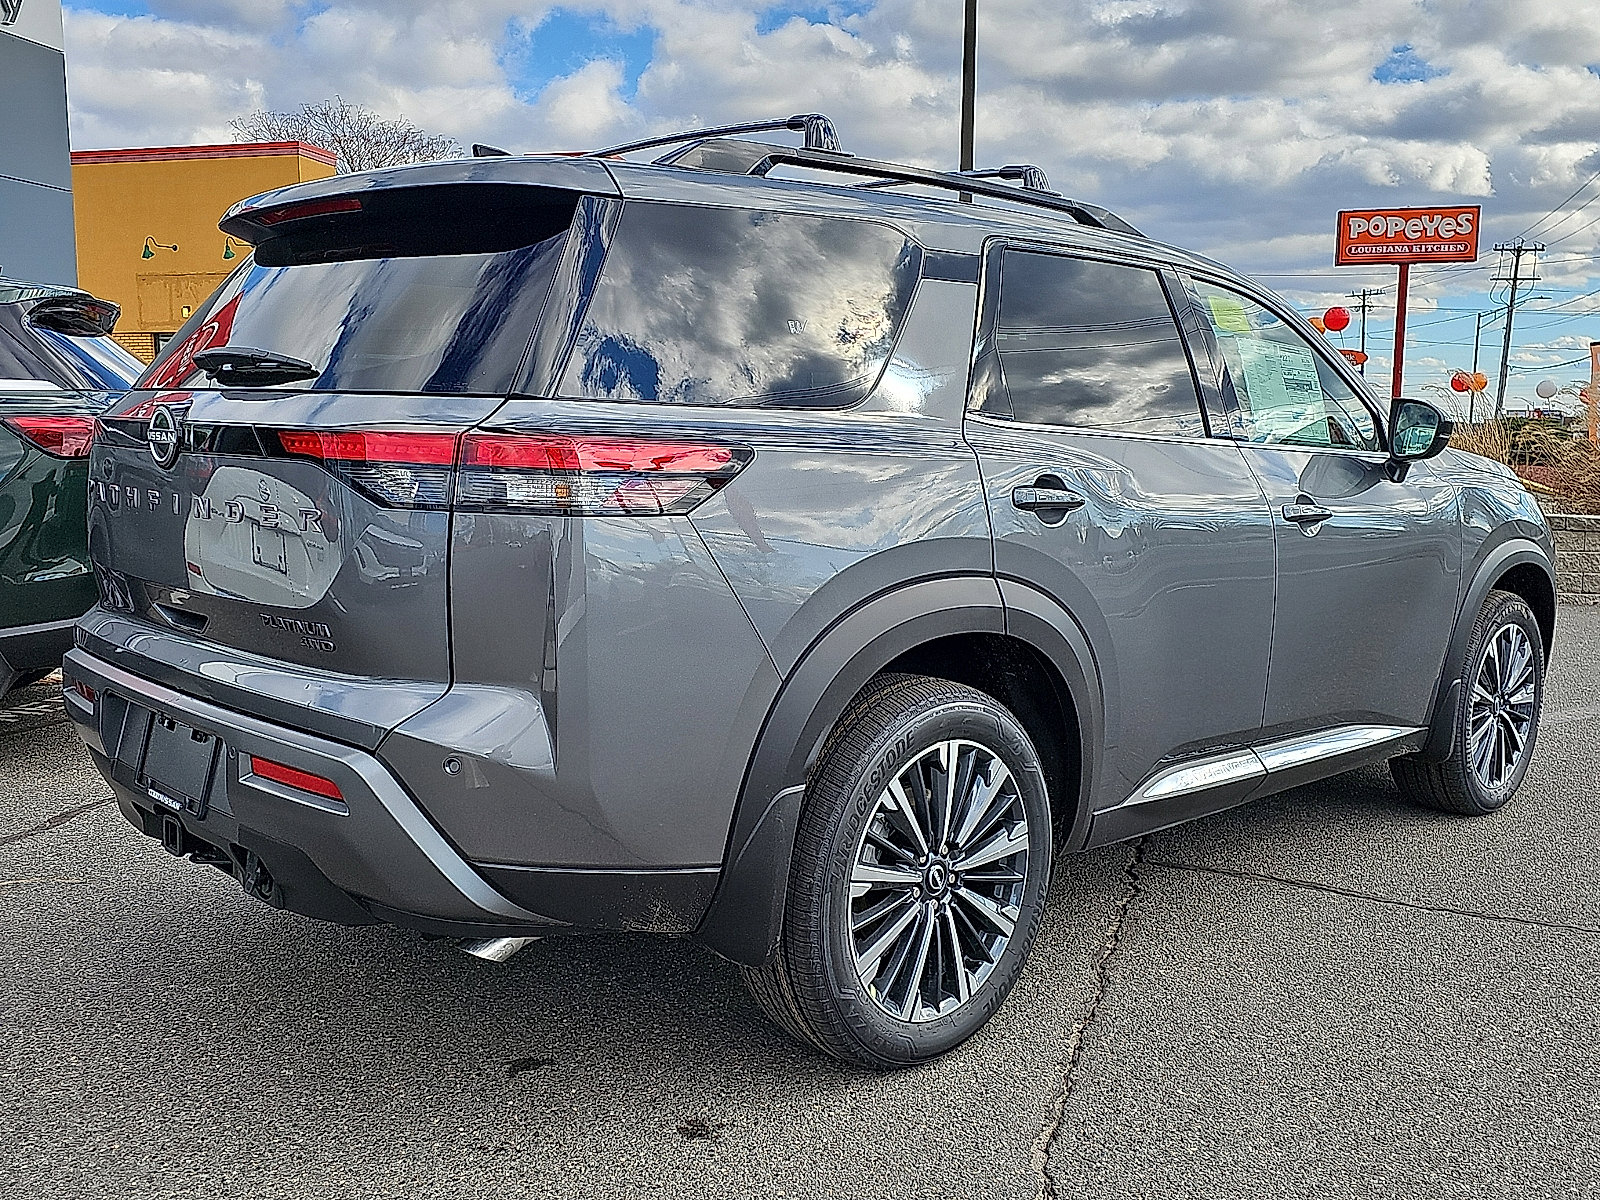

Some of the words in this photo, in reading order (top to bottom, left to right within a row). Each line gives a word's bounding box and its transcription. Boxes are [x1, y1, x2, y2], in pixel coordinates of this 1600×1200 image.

[1350, 245, 1410, 254] LOUISIANA
[1412, 243, 1467, 253] KITCHEN
[259, 613, 333, 638] PLATINUM
